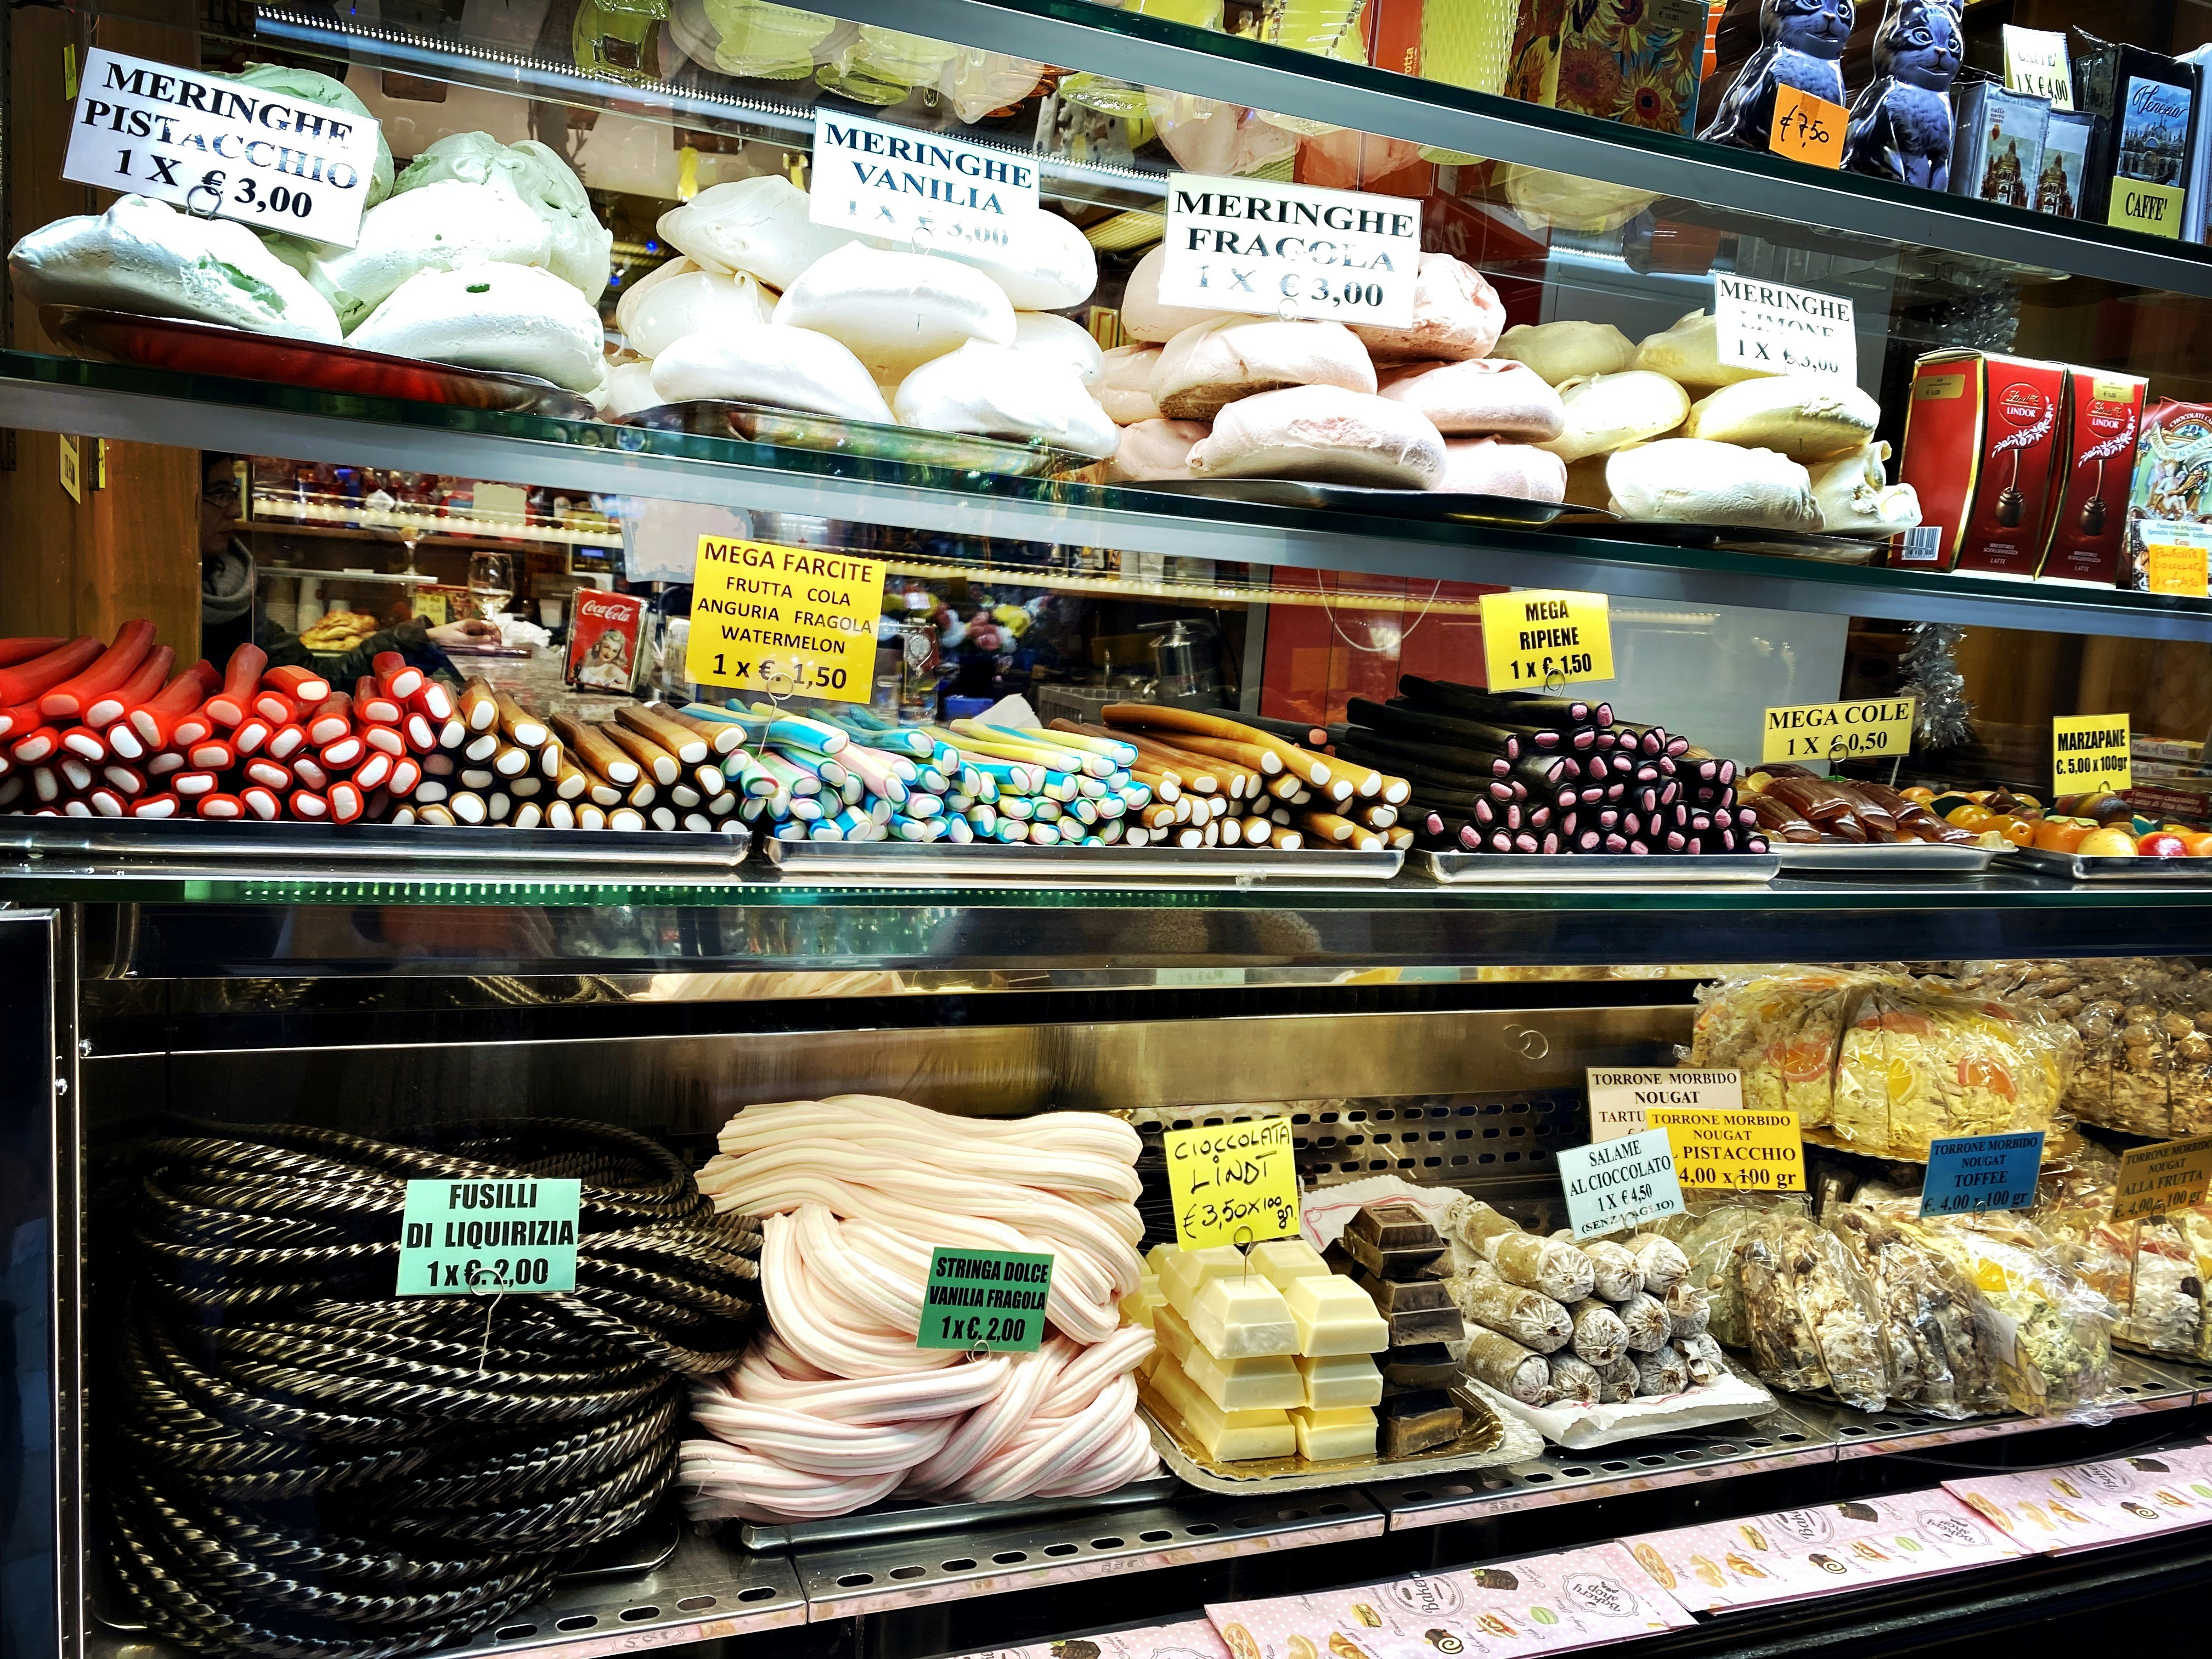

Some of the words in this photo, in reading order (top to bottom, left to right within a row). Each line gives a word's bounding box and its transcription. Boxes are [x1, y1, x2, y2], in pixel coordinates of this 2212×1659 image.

[2016, 74, 2022, 92] 1
[2024, 74, 2034, 94] X
[2038, 76, 2046, 97] €
[2047, 77, 2068, 104] 4,00
[2132, 84, 2188, 119] Venezia
[101, 61, 353, 149] MERINGHE
[80, 98, 358, 190] PISTACCHIO
[823, 122, 1032, 189] MERINGHE
[114, 149, 133, 176] 1
[145, 154, 183, 187] X
[200, 170, 227, 196] €
[234, 178, 313, 218] 3,00
[851, 161, 1006, 215] VANILIA
[1173, 190, 1414, 238] MERINGHE
[2125, 191, 2168, 221] CAFFE'
[1184, 227, 1396, 272] FRAGOLA
[1195, 264, 1210, 288] 1
[1227, 267, 1257, 293] X
[1278, 273, 1301, 297] €
[1311, 276, 1384, 308] 3,00
[1720, 279, 1850, 321] MERINGHE
[1737, 339, 1746, 356] 1
[1754, 341, 1771, 360] X
[2006, 406, 2036, 417] LINDOR
[2092, 417, 2120, 429] LINDOR
[704, 542, 775, 570] MEGA
[783, 553, 873, 583] FARCITE
[726, 576, 793, 599] FRUTTA
[806, 588, 851, 607] COLA
[697, 597, 780, 622] ANGURIA
[794, 610, 872, 634] FRAGOLA
[1525, 599, 1570, 622] MEGA
[721, 625, 846, 654] WATERMELON
[1519, 626, 1581, 651] RIPIENE
[712, 653, 727, 676] 1
[735, 660, 751, 678] x
[793, 663, 847, 690] 1,50
[1510, 660, 1520, 679] 1
[1526, 662, 1537, 678] x
[1560, 653, 1593, 676] 1,50
[1768, 708, 1840, 730] MEGA
[1845, 703, 1910, 724] COLE
[1787, 738, 1796, 756] 1
[1803, 736, 1820, 754] X
[1830, 734, 1844, 752] €
[1848, 731, 1888, 754] 0,50
[2057, 729, 2126, 752] MARZAPANE
[2068, 757, 2091, 775] 5,00
[1592, 1073, 1663, 1085] TORRONE
[1669, 1073, 1737, 1085] MORBIDO
[1635, 1091, 1701, 1104] NOUGAT
[1599, 1110, 1646, 1123] TARTU
[1652, 1114, 1720, 1125] TORRONE
[1723, 1115, 1791, 1126] MORBIDO
[1174, 1120, 1290, 1161] CIOCCOLATA
[1693, 1129, 1752, 1141] NOUGAT
[1934, 1141, 1987, 1156] TORRONE
[1987, 1136, 2038, 1151] MORBIDO
[1588, 1139, 1643, 1167] SALAME
[1682, 1146, 1796, 1161] PISTACCHIO
[1961, 1154, 2007, 1169] NOUGAT
[2125, 1147, 2171, 1165] TORRONE
[2171, 1139, 2212, 1155] MORBIDO
[1570, 1178, 1588, 1197] AL
[1588, 1155, 1671, 1190] CIOCCOLATO
[1679, 1166, 1716, 1187] 4,00
[1722, 1172, 1733, 1184] x
[1739, 1168, 1770, 1185] 100
[1776, 1173, 1796, 1189] gr
[1954, 1170, 2009, 1188] TOFFEE
[2147, 1158, 2187, 1175] NOUGAT
[449, 1183, 538, 1210] FUSILLI
[2121, 1178, 2154, 1197] ALLA
[2157, 1169, 2203, 1189] FRUTTA
[1597, 1196, 1605, 1212] 1
[1605, 1193, 1618, 1210] X
[1621, 1189, 1629, 1205] €
[1631, 1183, 1653, 1205] 4,50
[1940, 1193, 1970, 1214] 4,00
[1987, 1189, 2011, 1207] 100
[2011, 1192, 2029, 1208] gr
[2128, 1197, 2154, 1217] 4,00
[2166, 1190, 2187, 1207] 100
[2188, 1189, 2204, 1206] gr
[1581, 1212, 1625, 1234] (SENZA
[1632, 1199, 1675, 1218] AGLIO)
[406, 1222, 433, 1249] DI
[444, 1220, 574, 1250] LIQUIRIZIA
[427, 1260, 439, 1287] 1
[443, 1264, 459, 1286] x
[493, 1257, 549, 1288] 2,00
[935, 1256, 1002, 1281] STRINGA
[1003, 1261, 1049, 1284] DOLCE
[929, 1285, 984, 1308] VANILIA
[986, 1288, 1046, 1311] FRAGOLA
[941, 1315, 952, 1339] 1
[951, 1319, 966, 1340] x
[985, 1317, 1026, 1344] 2,00
[2084, 1464, 2119, 1489] Bake
[1413, 1577, 1441, 1613] Baker
[1572, 1583, 1621, 1612] Bakery
[1587, 1584, 1619, 1601] shop
